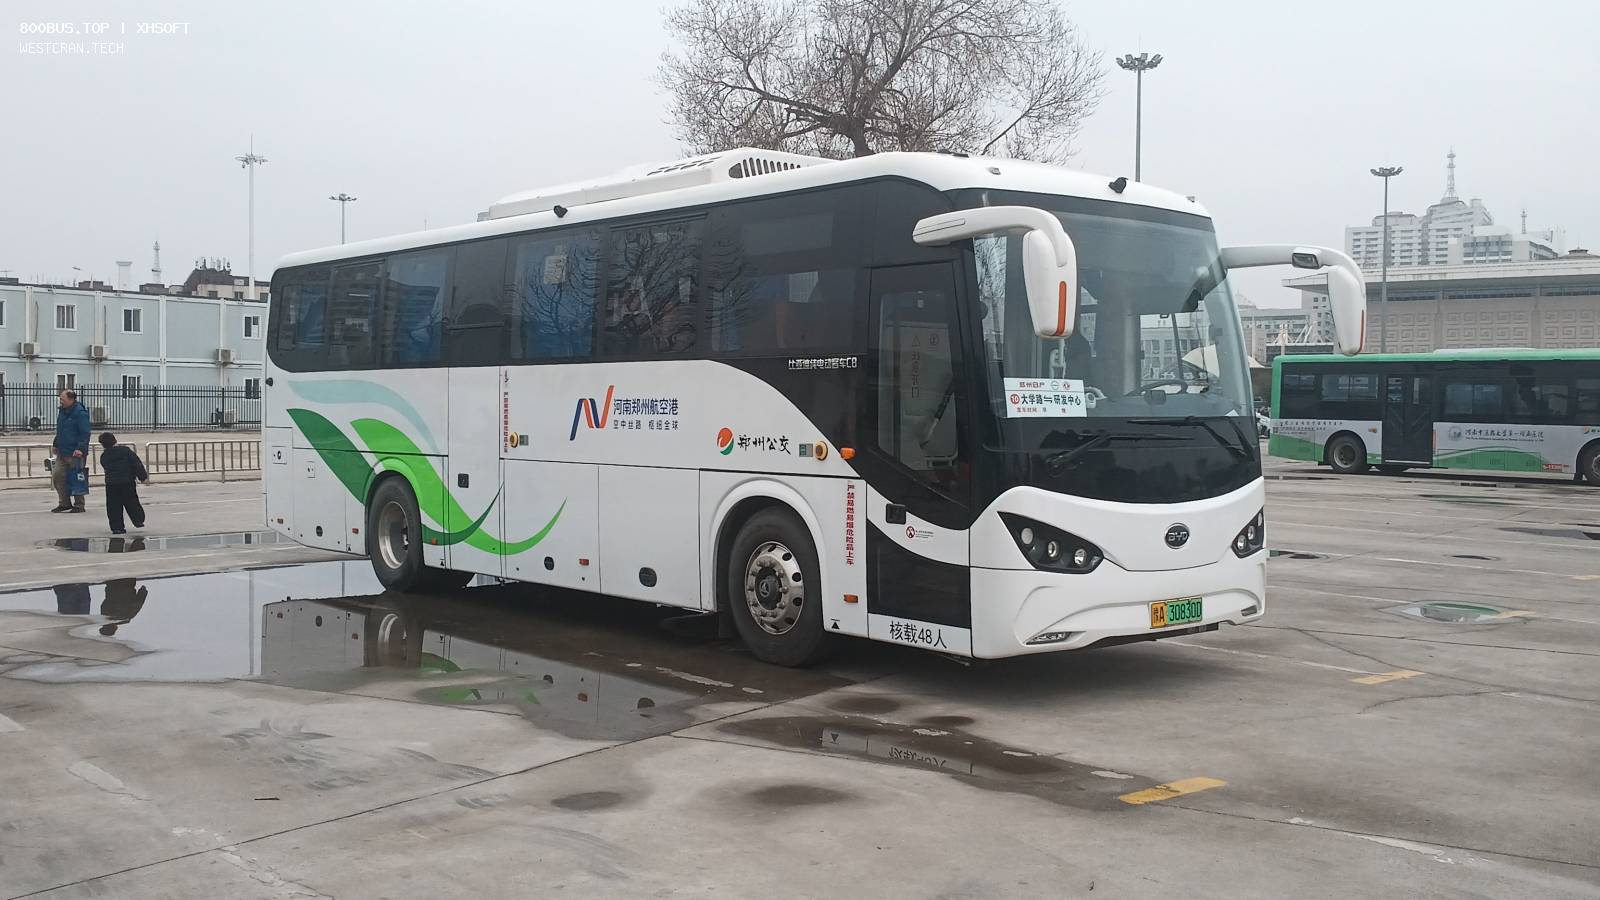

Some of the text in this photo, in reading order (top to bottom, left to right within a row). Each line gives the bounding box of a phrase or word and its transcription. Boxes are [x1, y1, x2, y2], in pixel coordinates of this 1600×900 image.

[613, 398, 679, 416] 河南郑州航空港
[737, 434, 791, 455] 郑州公交
[1168, 530, 1189, 542] BYD
[889, 620, 947, 648] 核载48人
